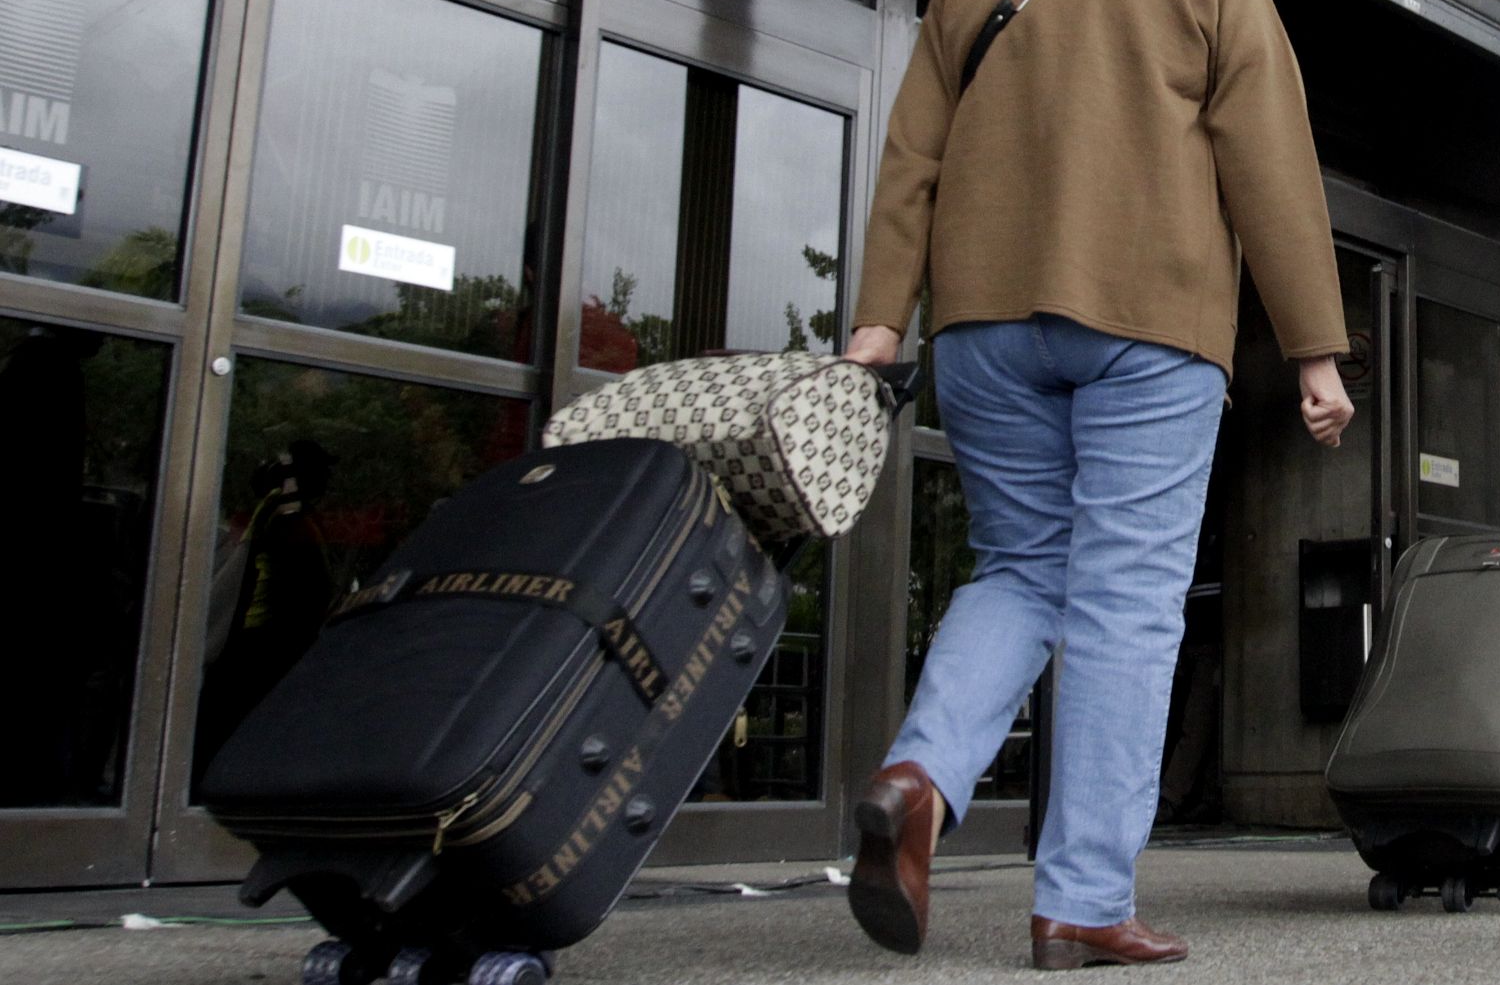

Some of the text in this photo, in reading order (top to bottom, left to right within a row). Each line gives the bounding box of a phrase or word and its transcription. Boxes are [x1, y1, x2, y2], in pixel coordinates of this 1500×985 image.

[359, 180, 447, 234] IAIM
[375, 239, 435, 268] Entrada
[415, 572, 576, 603] AIRLINER
[604, 618, 659, 699] AIRL
[660, 569, 753, 721] AIRLINER
[502, 744, 644, 906] AIRLINER
